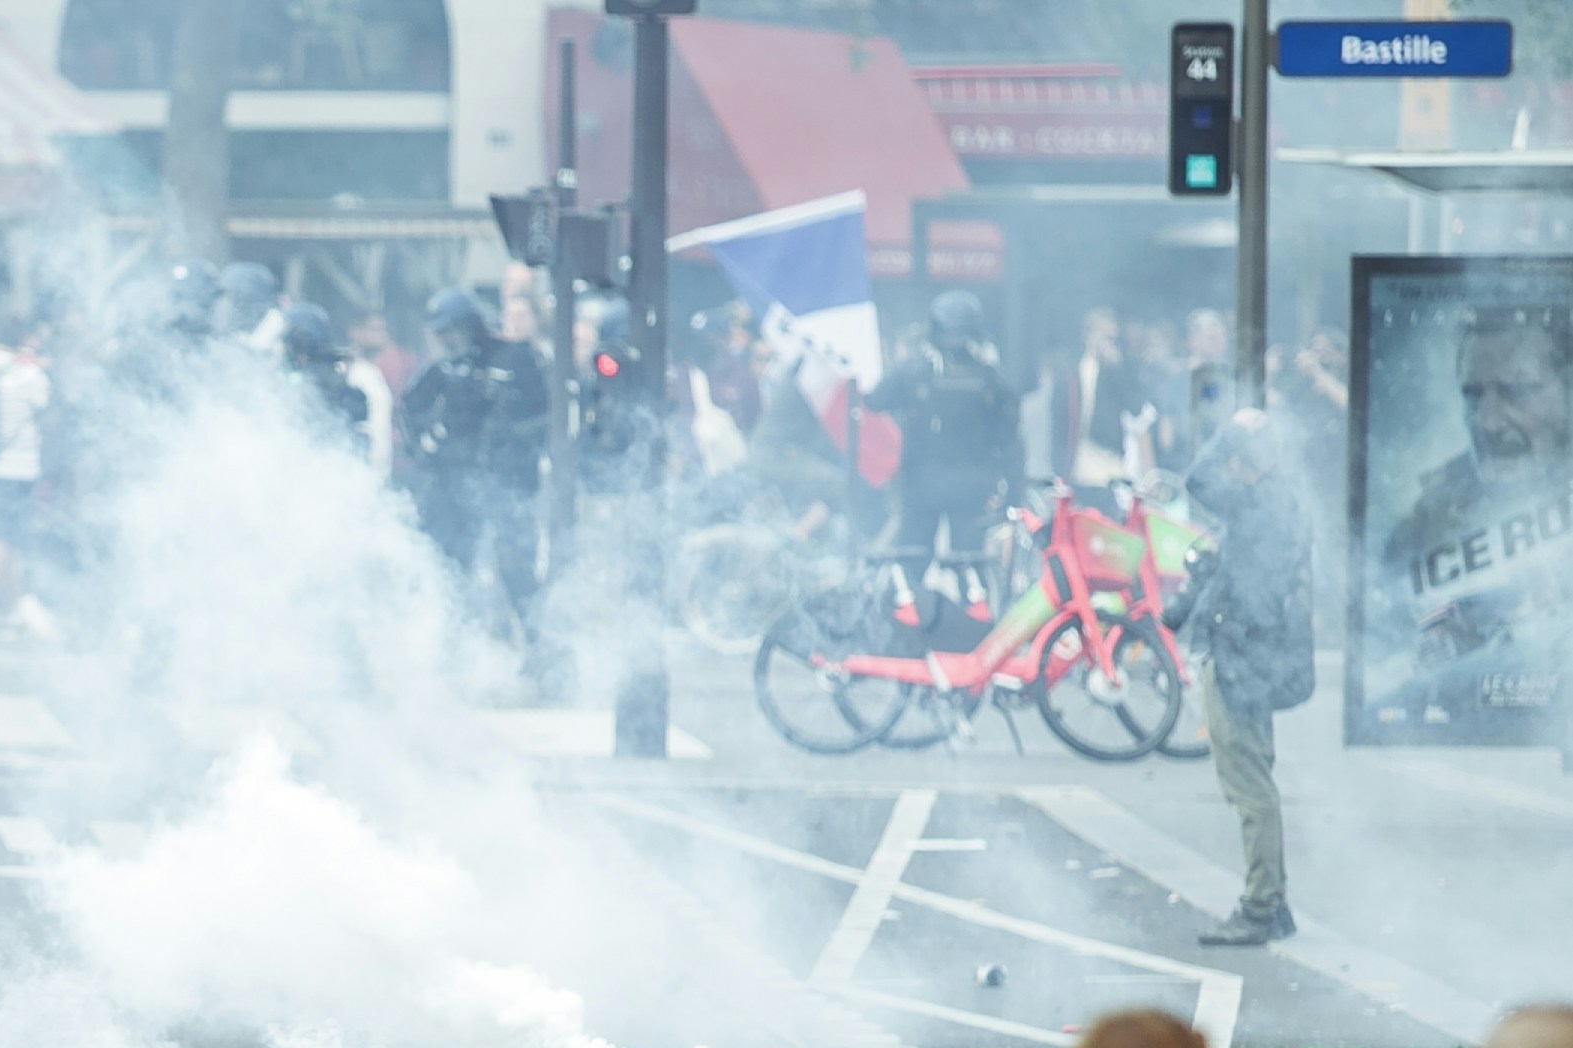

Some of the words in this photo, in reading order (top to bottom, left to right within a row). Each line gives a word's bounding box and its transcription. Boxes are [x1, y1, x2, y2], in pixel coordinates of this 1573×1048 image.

[1341, 36, 1447, 65] Bastille
[1186, 58, 1217, 81] 44
[1409, 528, 1492, 595] ICE
